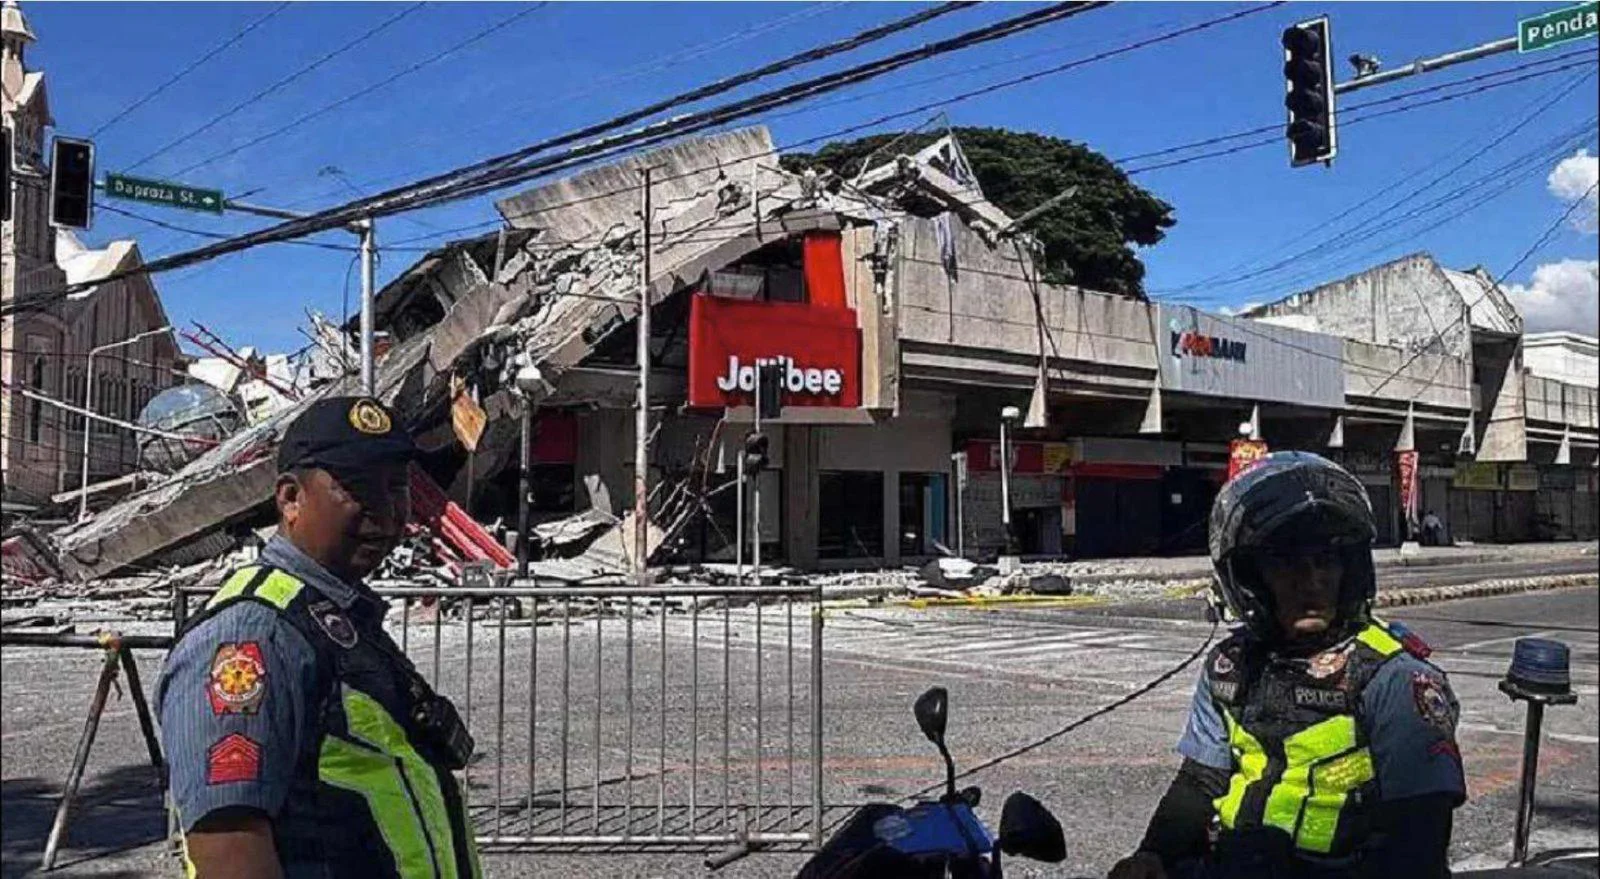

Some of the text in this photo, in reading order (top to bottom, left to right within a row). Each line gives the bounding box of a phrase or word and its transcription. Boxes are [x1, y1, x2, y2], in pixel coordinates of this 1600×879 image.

[1527, 12, 1597, 43] Penda
[115, 180, 197, 204] Daproza St.
[717, 354, 842, 395] Joibee
[1295, 687, 1345, 706] POLICE
